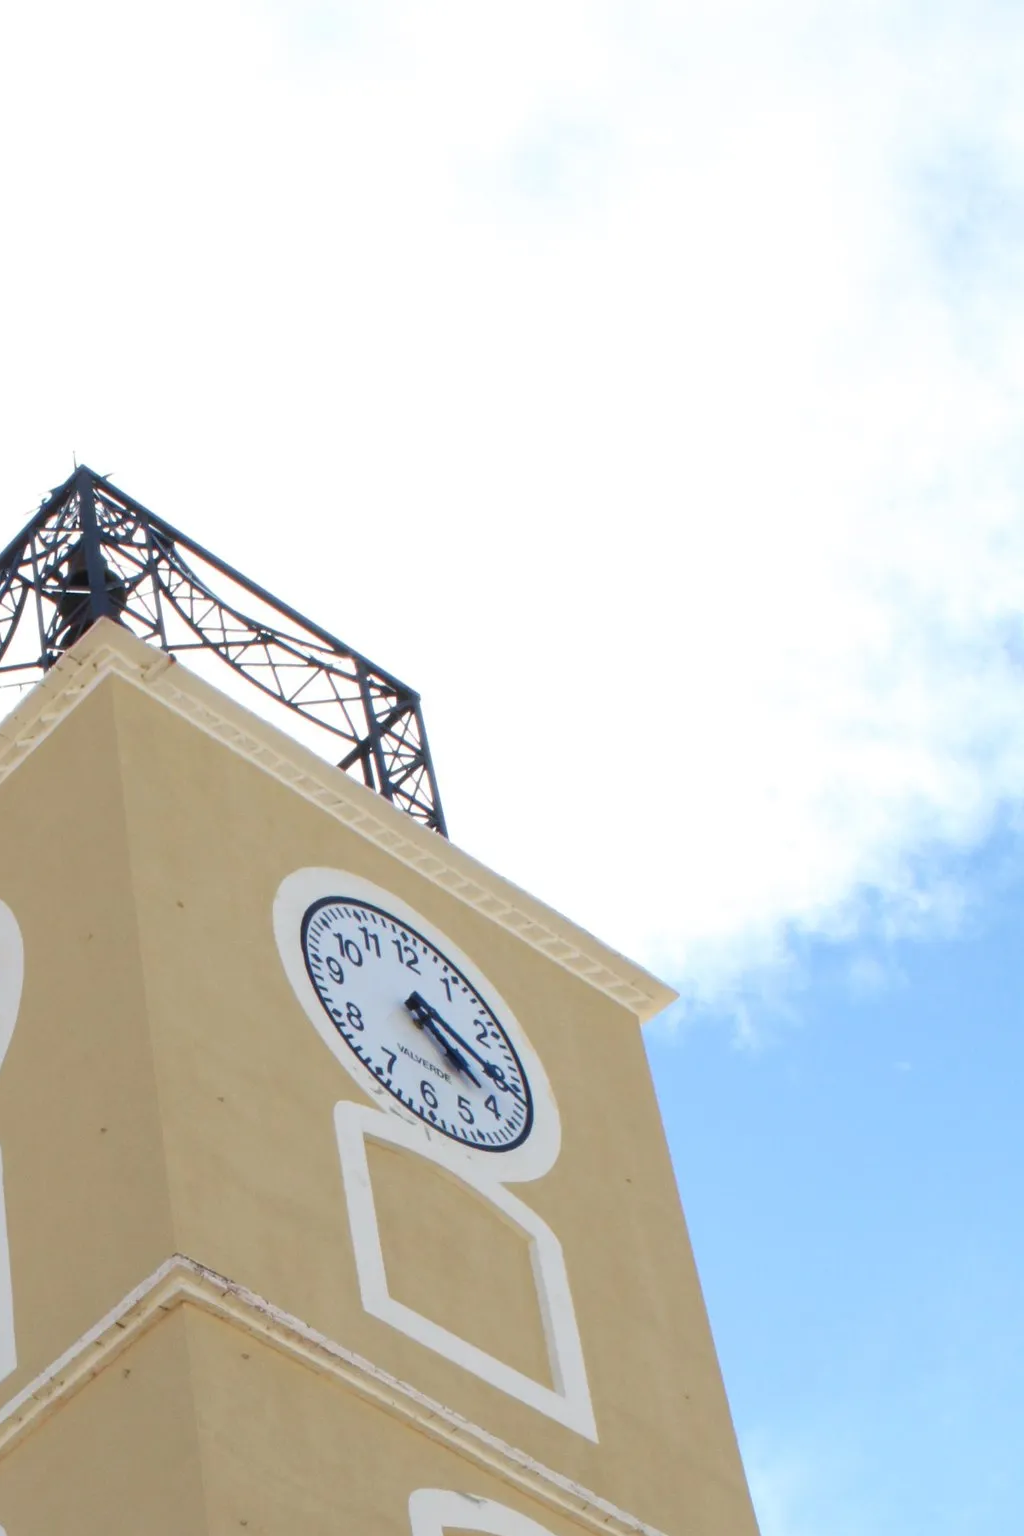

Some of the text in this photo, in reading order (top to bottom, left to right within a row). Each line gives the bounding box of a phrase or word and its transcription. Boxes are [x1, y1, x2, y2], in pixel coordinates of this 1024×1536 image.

[334, 933, 363, 967] 10
[359, 927, 381, 958] 11
[326, 956, 343, 984] 9
[392, 939, 421, 975] 12
[440, 978, 451, 1001] 1
[346, 1002, 364, 1032] 8
[474, 1019, 490, 1048] 2
[381, 1047, 396, 1074] 7
[397, 1043, 452, 1084] VALVERDE
[420, 1080, 438, 1108] 6
[485, 1095, 500, 1120] 4
[458, 1096, 474, 1124] 5
